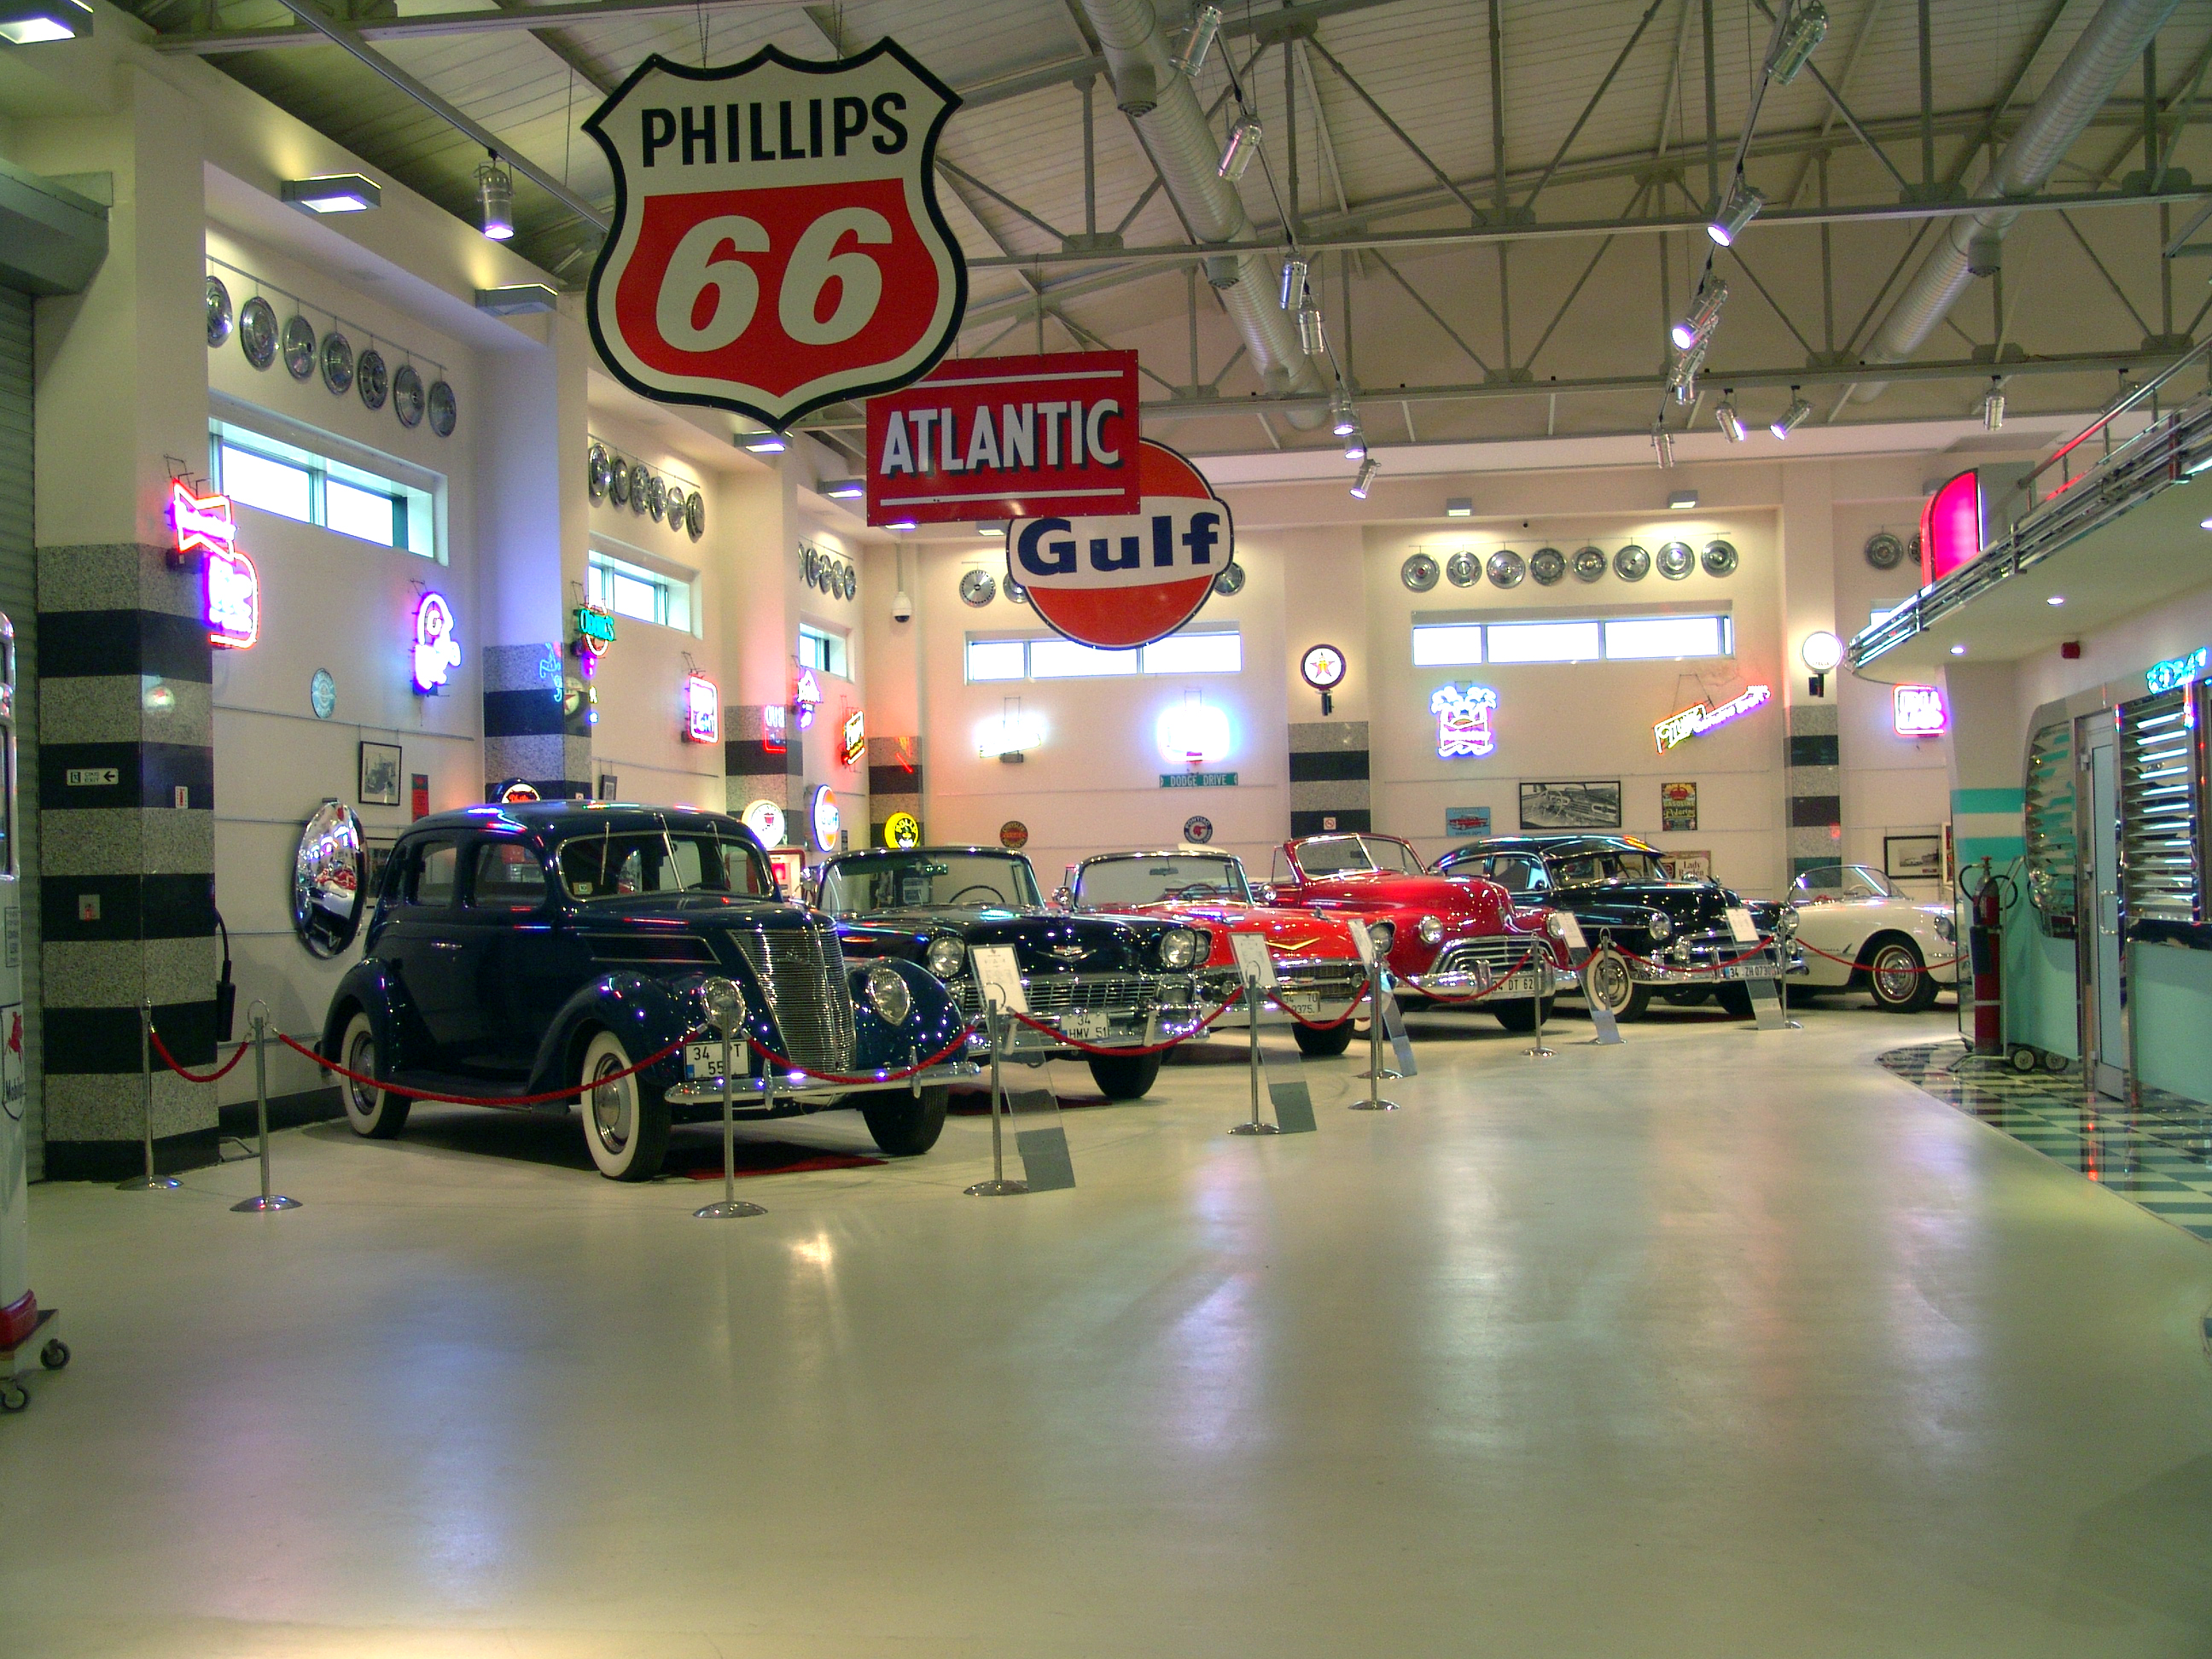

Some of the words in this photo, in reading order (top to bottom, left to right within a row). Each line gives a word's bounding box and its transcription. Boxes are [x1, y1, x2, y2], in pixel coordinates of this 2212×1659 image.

[642, 92, 908, 168] PHILLIPS
[655, 207, 892, 352] 66
[879, 398, 1125, 480] ATLANTIC
[1017, 511, 1220, 576] Gulf
[1170, 775, 1197, 786] DODGE
[1203, 774, 1226, 785] DRIVE
[1185, 817, 1210, 829] PONTIAC
[1683, 860, 1700, 870] Lady
[1729, 968, 1739, 978] 34
[1508, 979, 1518, 991] DT
[1078, 1015, 1091, 1026] 34
[1068, 1027, 1090, 1039] HMV
[1095, 1027, 1107, 1038] 51
[693, 1046, 710, 1061] 34
[729, 1044, 741, 1057] T
